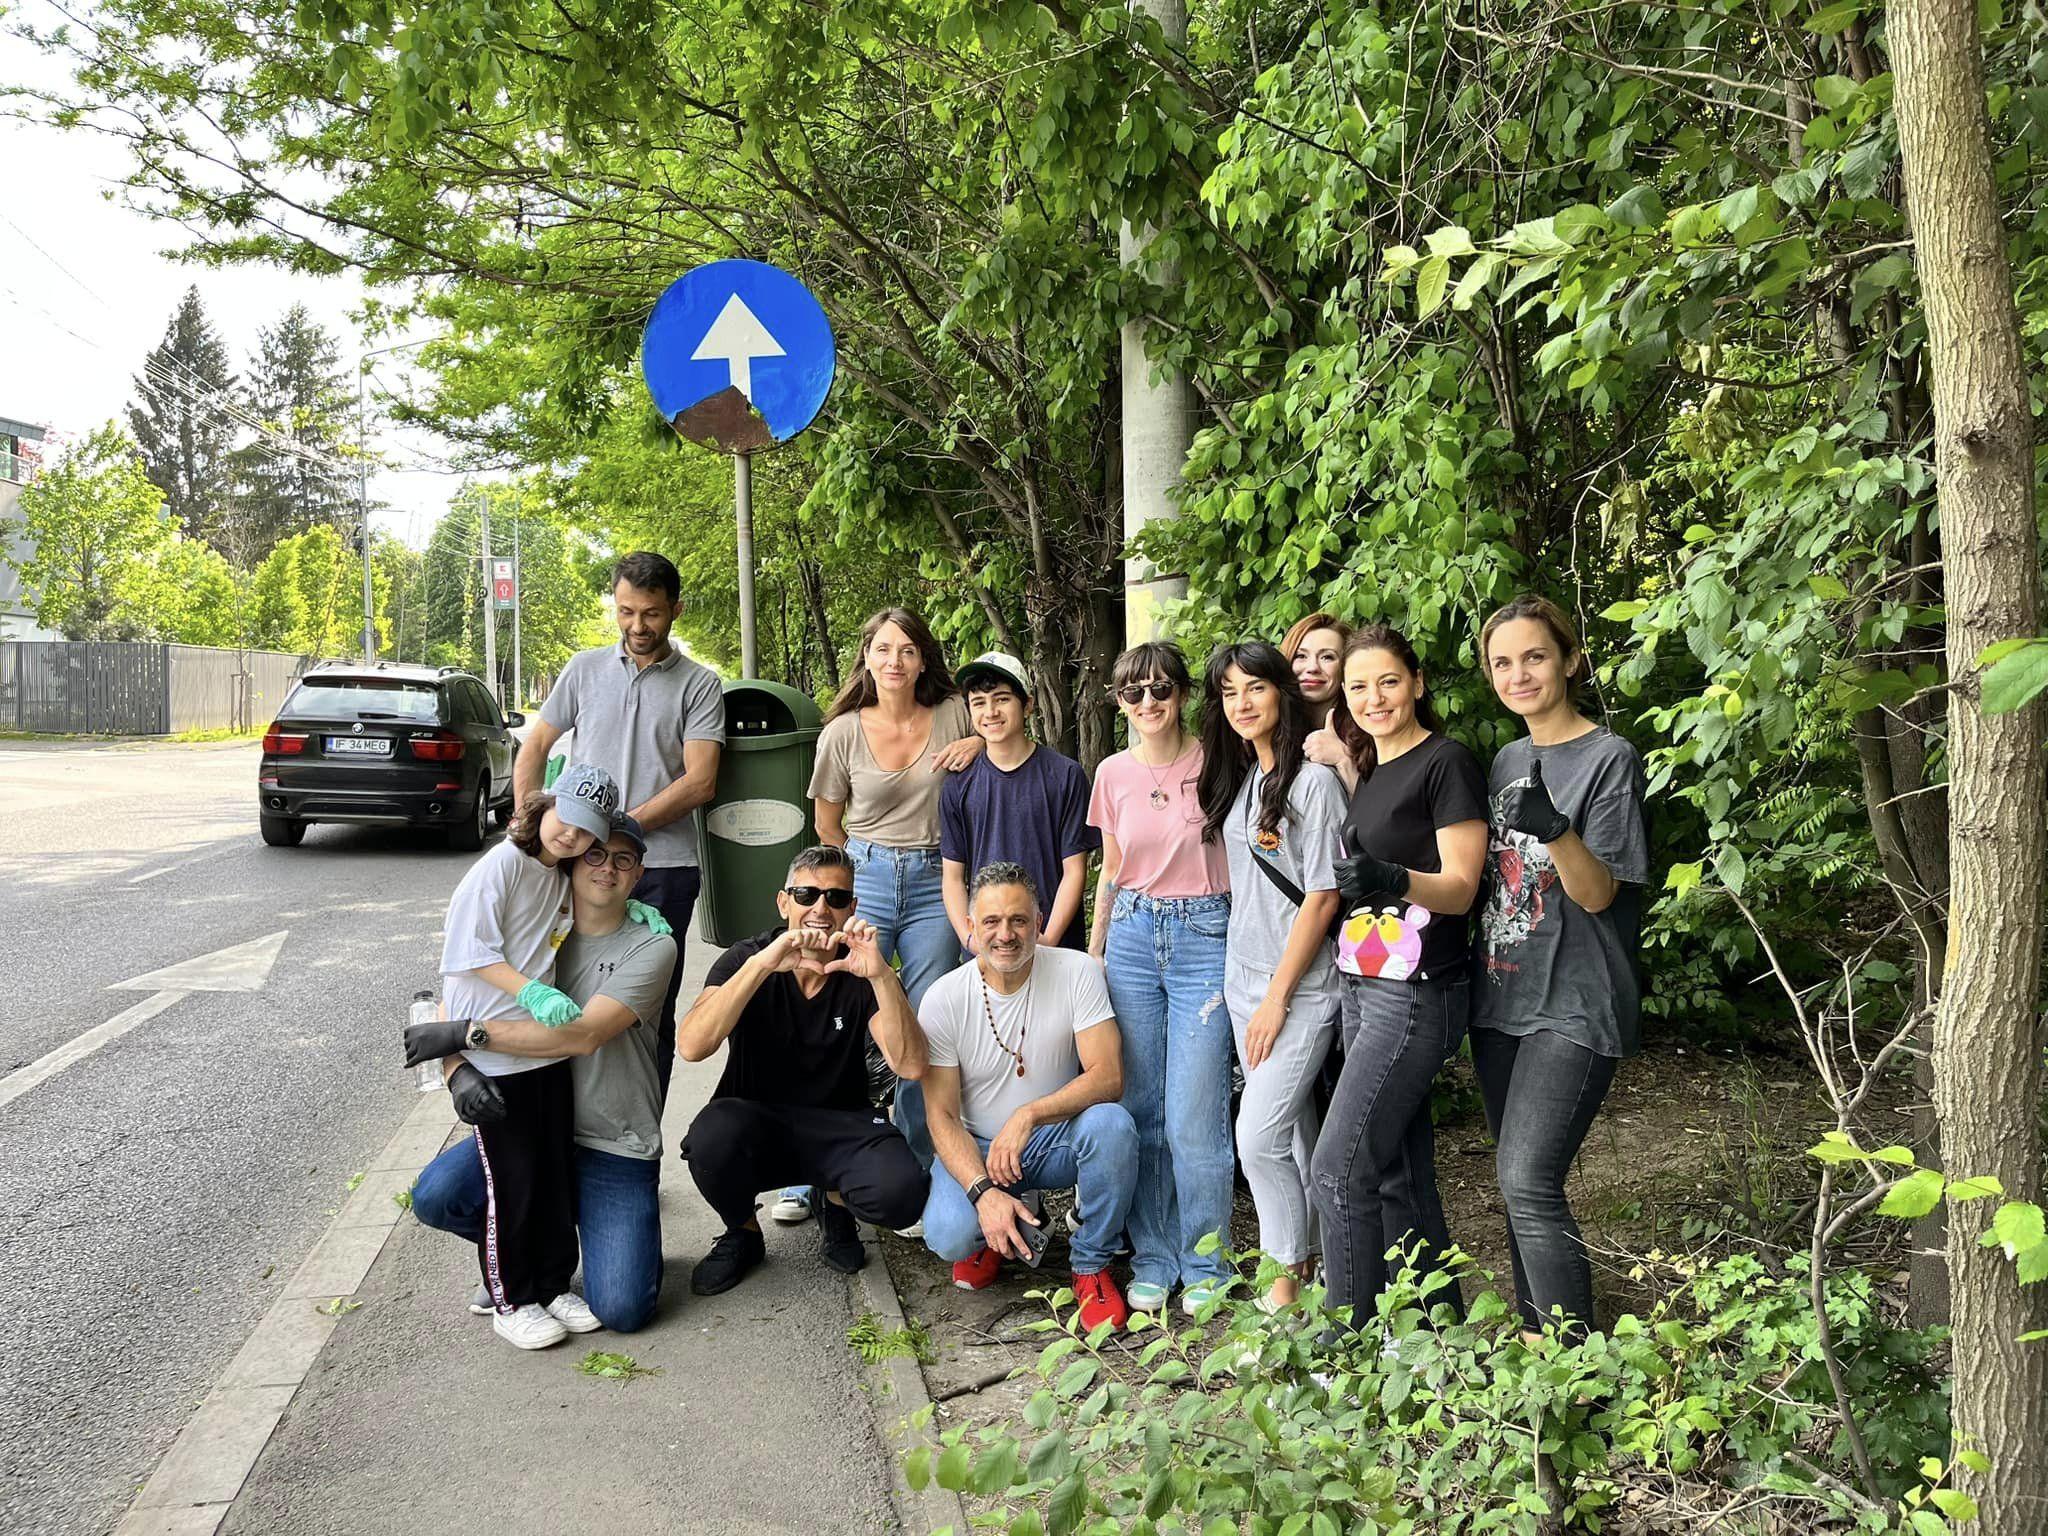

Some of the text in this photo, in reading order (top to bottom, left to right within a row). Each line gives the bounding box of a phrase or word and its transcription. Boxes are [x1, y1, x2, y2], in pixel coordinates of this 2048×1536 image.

[335, 739, 386, 750] IF 34 MEG
[574, 780, 614, 812] GAP
[488, 1215, 496, 1241] LOVE
[488, 1242, 496, 1252] IS
[489, 1254, 497, 1276] NEED
